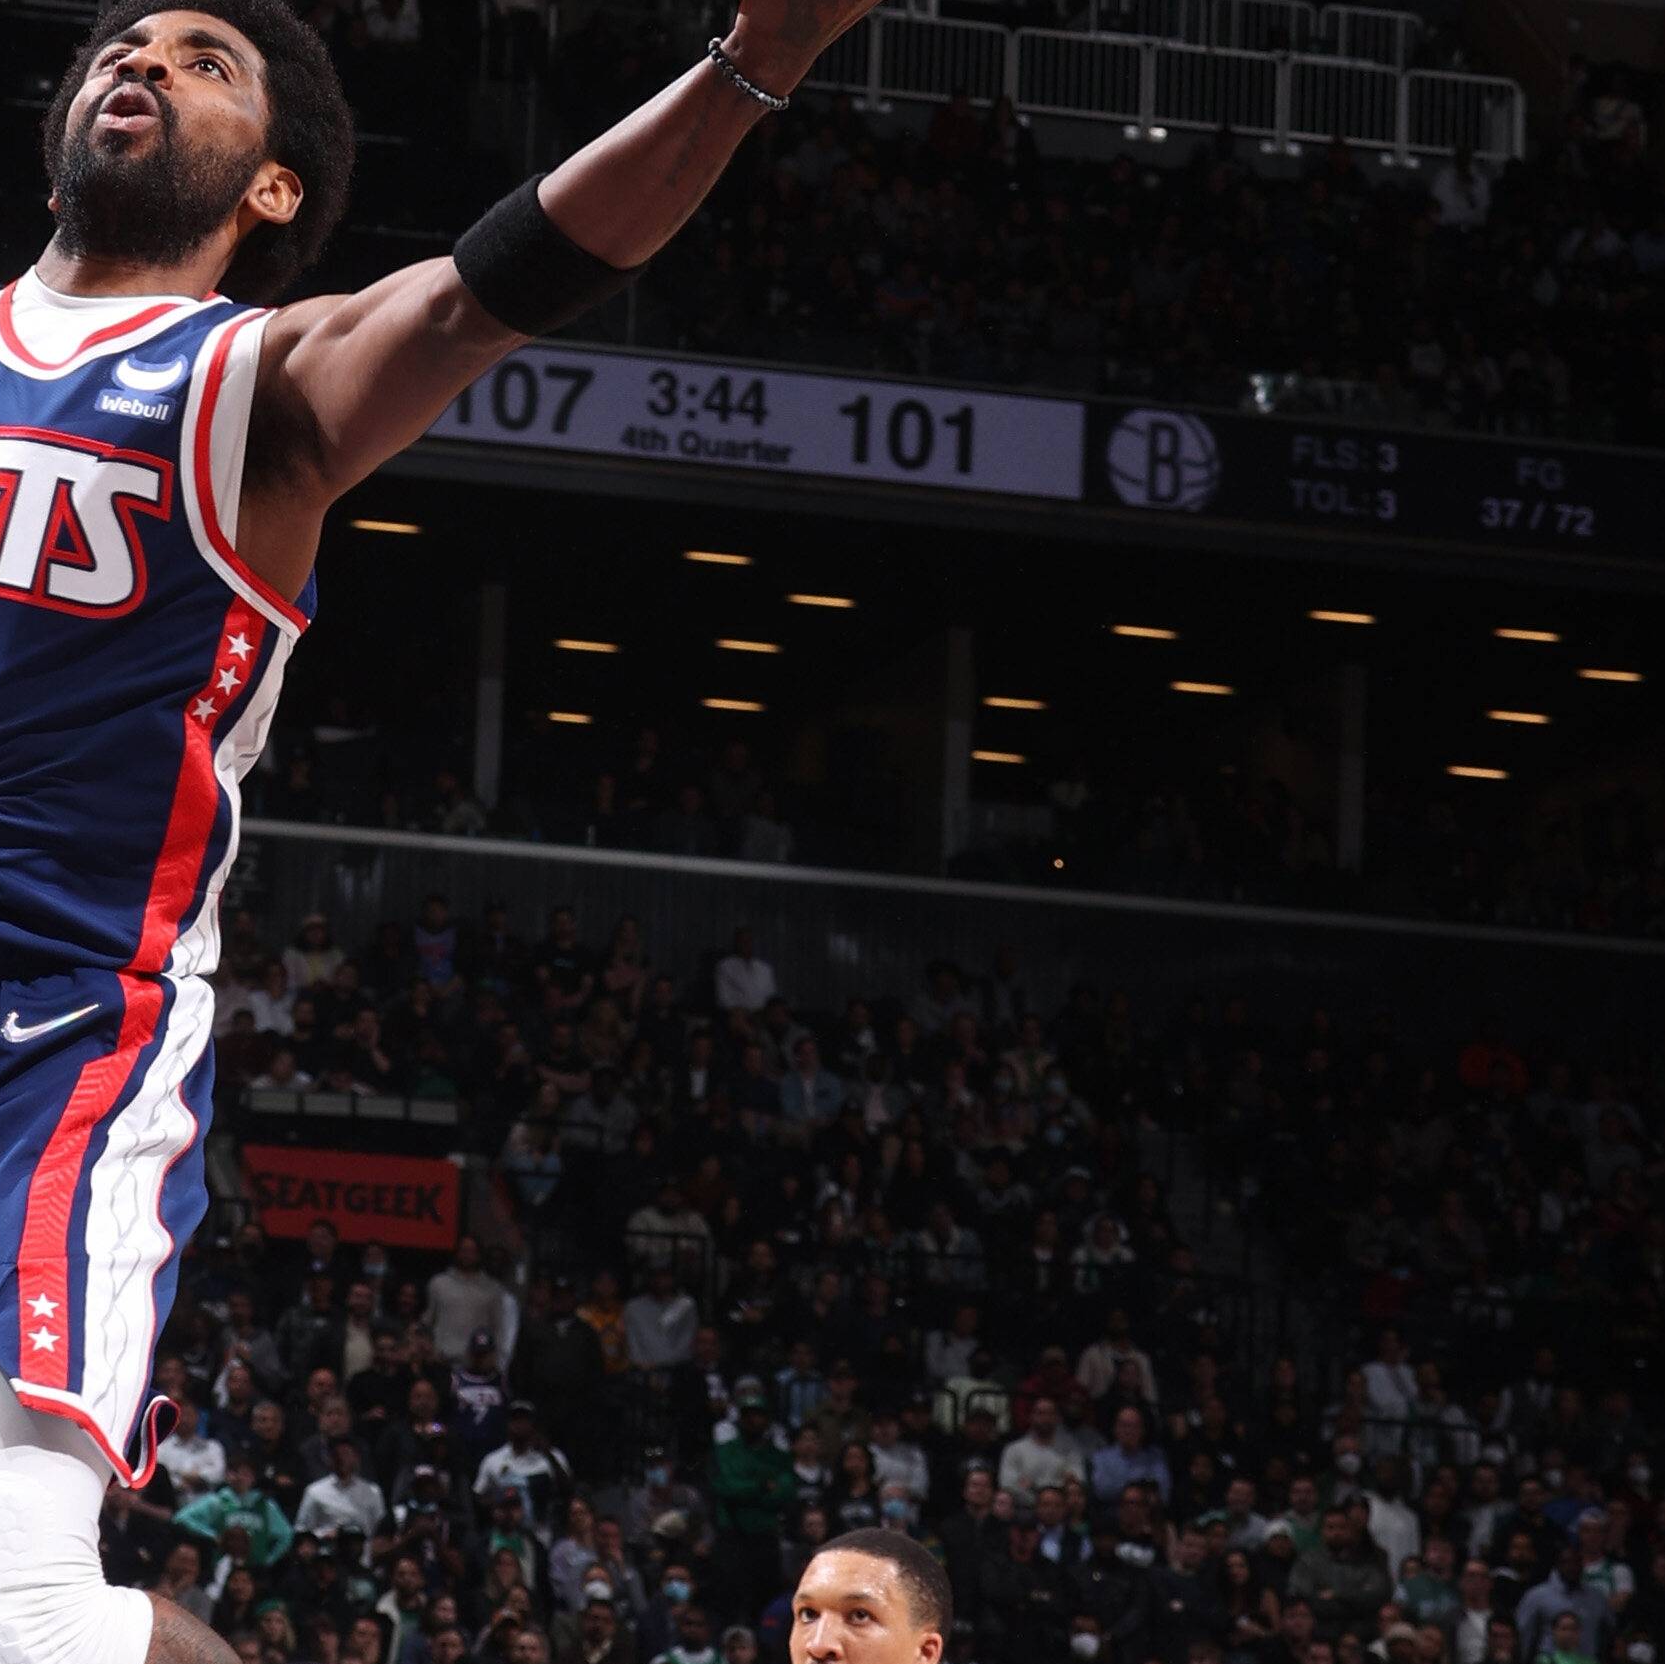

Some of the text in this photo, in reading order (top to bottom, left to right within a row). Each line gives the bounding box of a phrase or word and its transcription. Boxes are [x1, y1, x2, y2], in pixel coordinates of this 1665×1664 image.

[98, 393, 170, 422] Webull
[648, 369, 768, 426] 3:44
[839, 394, 976, 474] 101
[622, 423, 792, 463] 4th Quarter
[1378, 440, 1400, 474] 3
[1377, 488, 1399, 521] 3
[249, 1171, 445, 1226] SEATGEEK
